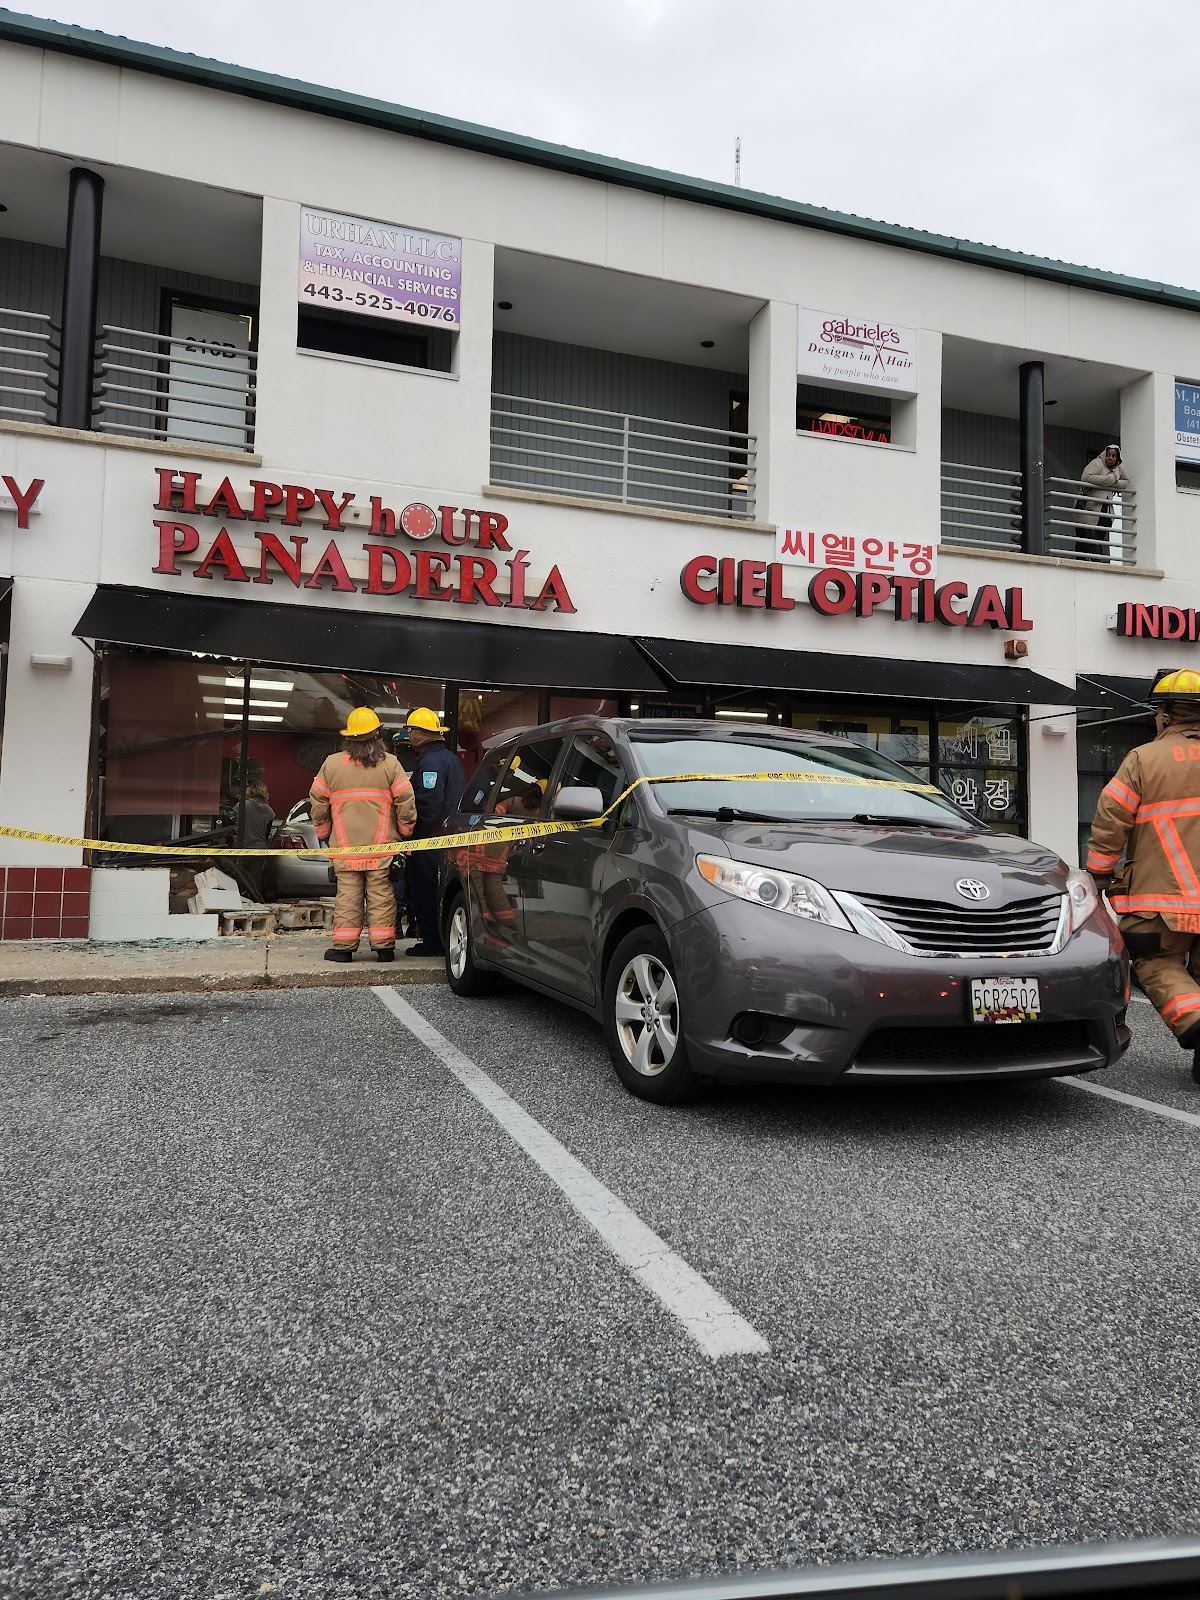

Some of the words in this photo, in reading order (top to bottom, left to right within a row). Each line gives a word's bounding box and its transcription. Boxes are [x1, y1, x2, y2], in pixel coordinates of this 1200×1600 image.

[305, 213, 398, 251] URHAN
[303, 260, 315, 273] &
[319, 263, 393, 288] FINANCIAL
[397, 278, 458, 300] SERVICES
[314, 243, 349, 263] TAX,
[352, 251, 452, 281] ACCOUNTING
[303, 282, 455, 322] 443-525-4076
[820, 318, 901, 344] gabriele's
[808, 342, 855, 359] Designs
[859, 350, 871, 362] in
[886, 355, 913, 368] Hair
[822, 364, 832, 374] by
[834, 366, 861, 378] people
[863, 371, 879, 381] who
[153, 467, 356, 532] HAPPY
[152, 520, 578, 614] PANADERÍA
[781, 529, 932, 576] 씨엘안경
[680, 555, 795, 611] CIEL
[807, 567, 1033, 632] OPTICAL
[1117, 602, 1200, 643] INDI
[511, 827, 524, 838] FIRE
[526, 825, 541, 836] LINE
[974, 988, 1038, 1013] 5CR2502
